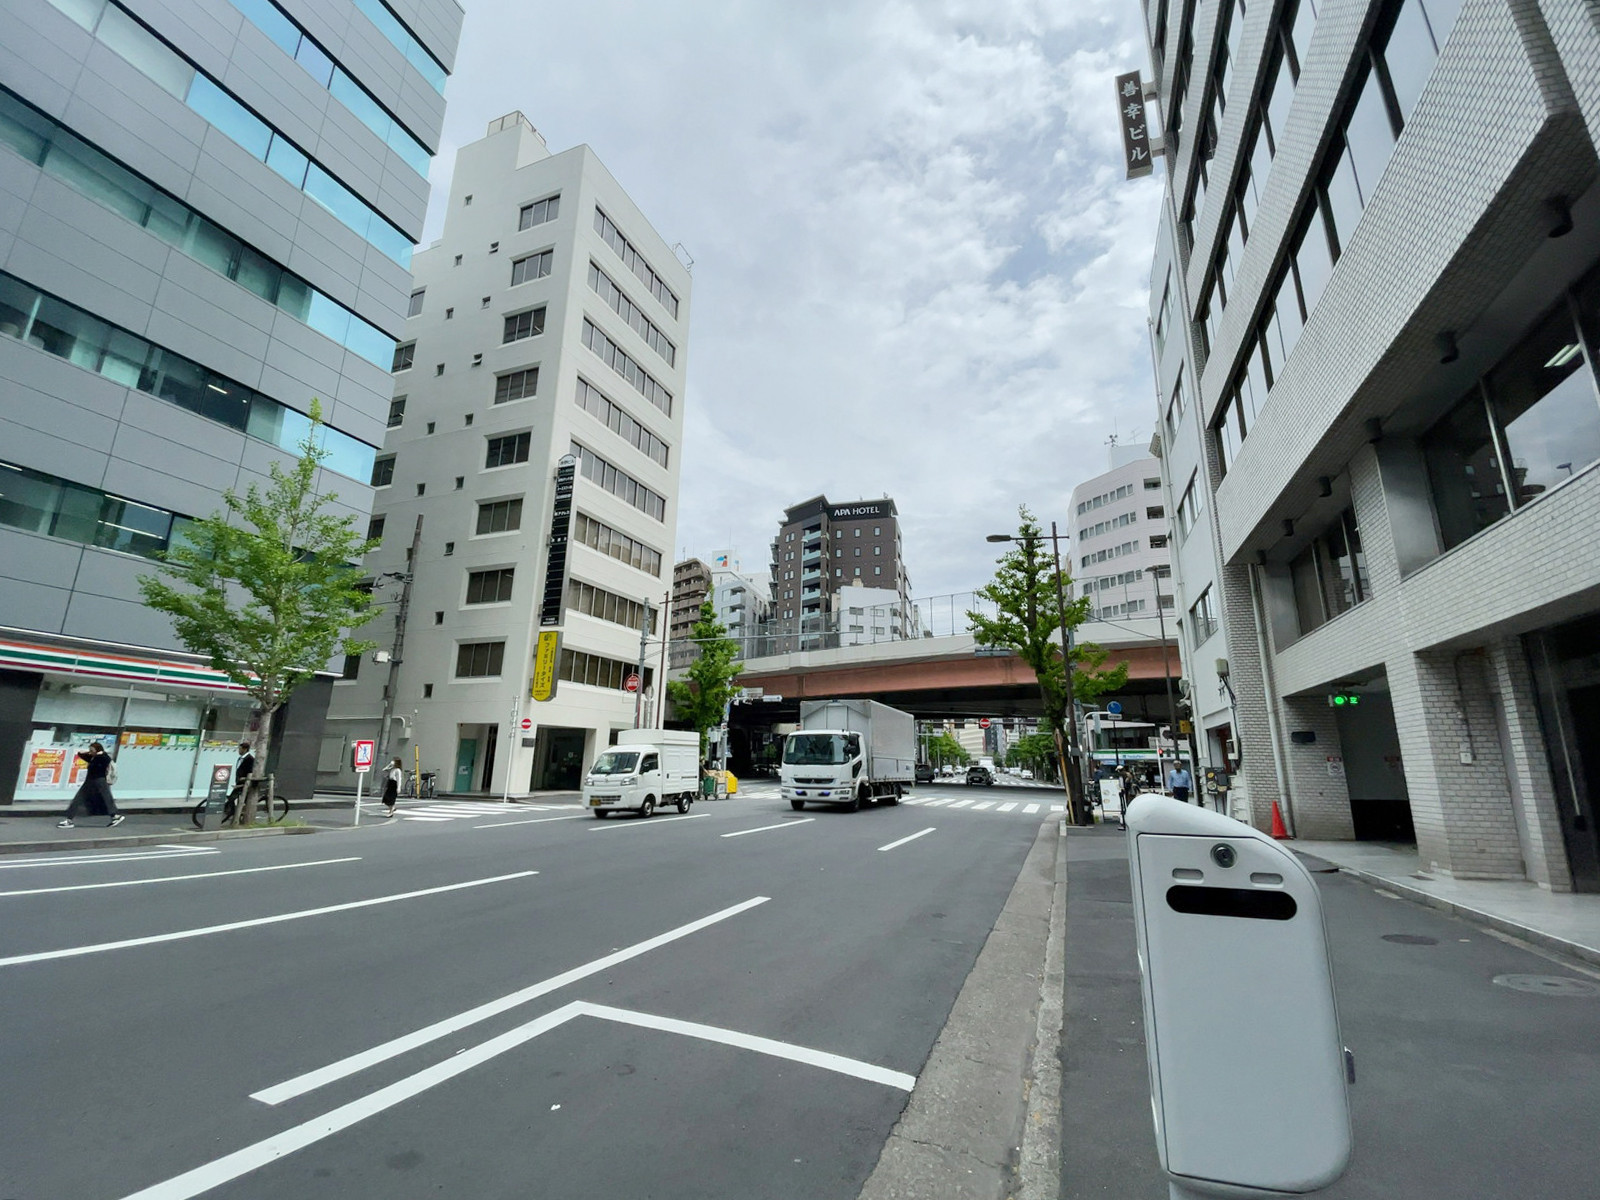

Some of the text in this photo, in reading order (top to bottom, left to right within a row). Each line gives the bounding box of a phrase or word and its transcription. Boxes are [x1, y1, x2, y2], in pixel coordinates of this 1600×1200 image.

[1120, 80, 1149, 162] 善幸ビル
[833, 506, 880, 517] APA HOTEL
